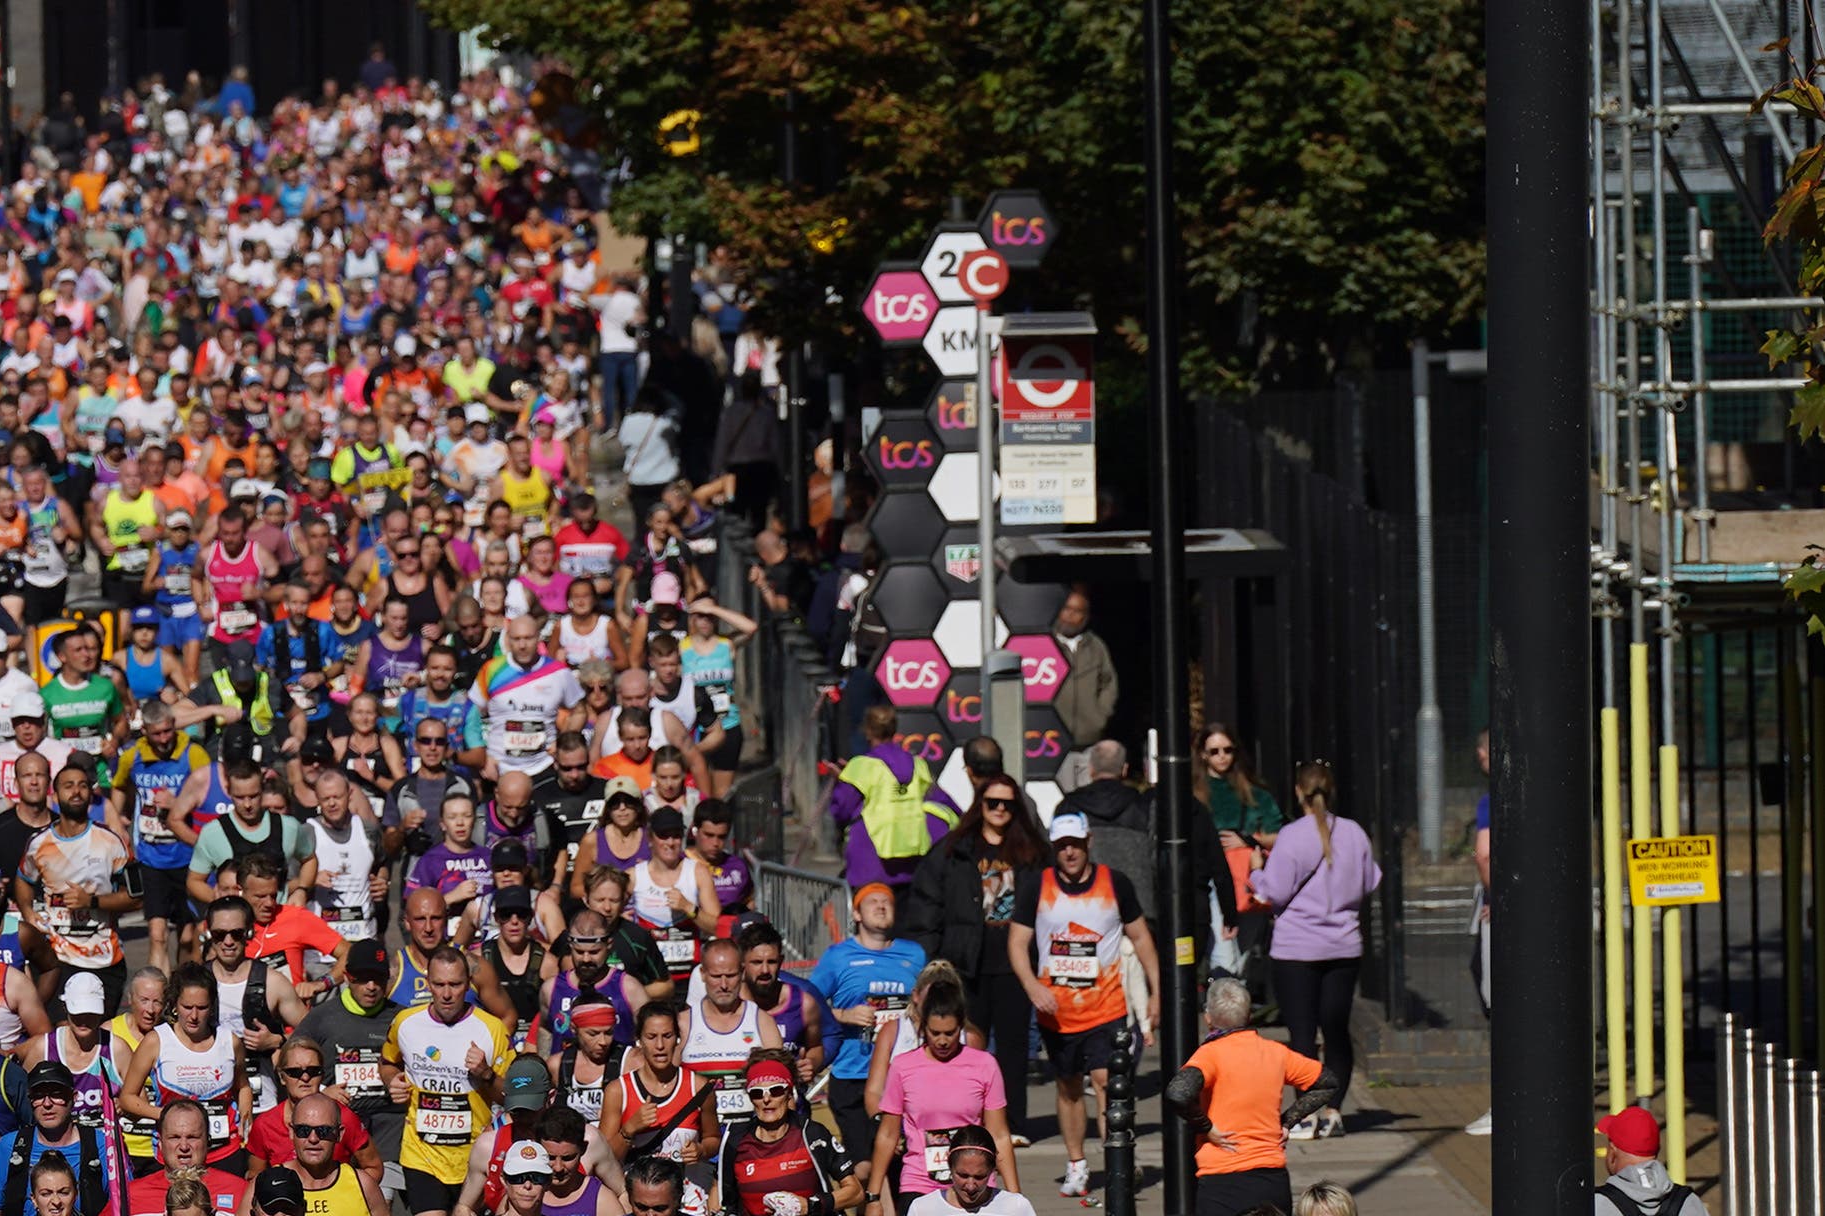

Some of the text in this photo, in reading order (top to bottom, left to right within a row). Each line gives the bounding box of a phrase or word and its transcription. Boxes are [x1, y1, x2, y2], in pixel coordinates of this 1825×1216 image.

[993, 212, 1045, 245] tcs
[939, 252, 957, 277] 2
[967, 256, 999, 295] C
[875, 290, 928, 323] tcs
[939, 395, 978, 429] tc
[880, 435, 934, 469] tcs
[886, 656, 940, 690] tcs
[1024, 658, 1058, 687] cs
[1024, 730, 1061, 758] cs
[135, 772, 184, 787] KENNY
[1636, 840, 1707, 858] CAUTION
[445, 858, 487, 872] PAULA
[412, 1053, 427, 1065] The
[421, 1077, 462, 1093] CRAIG
[423, 1110, 465, 1128] 48775
[304, 1199, 329, 1215] LEE
